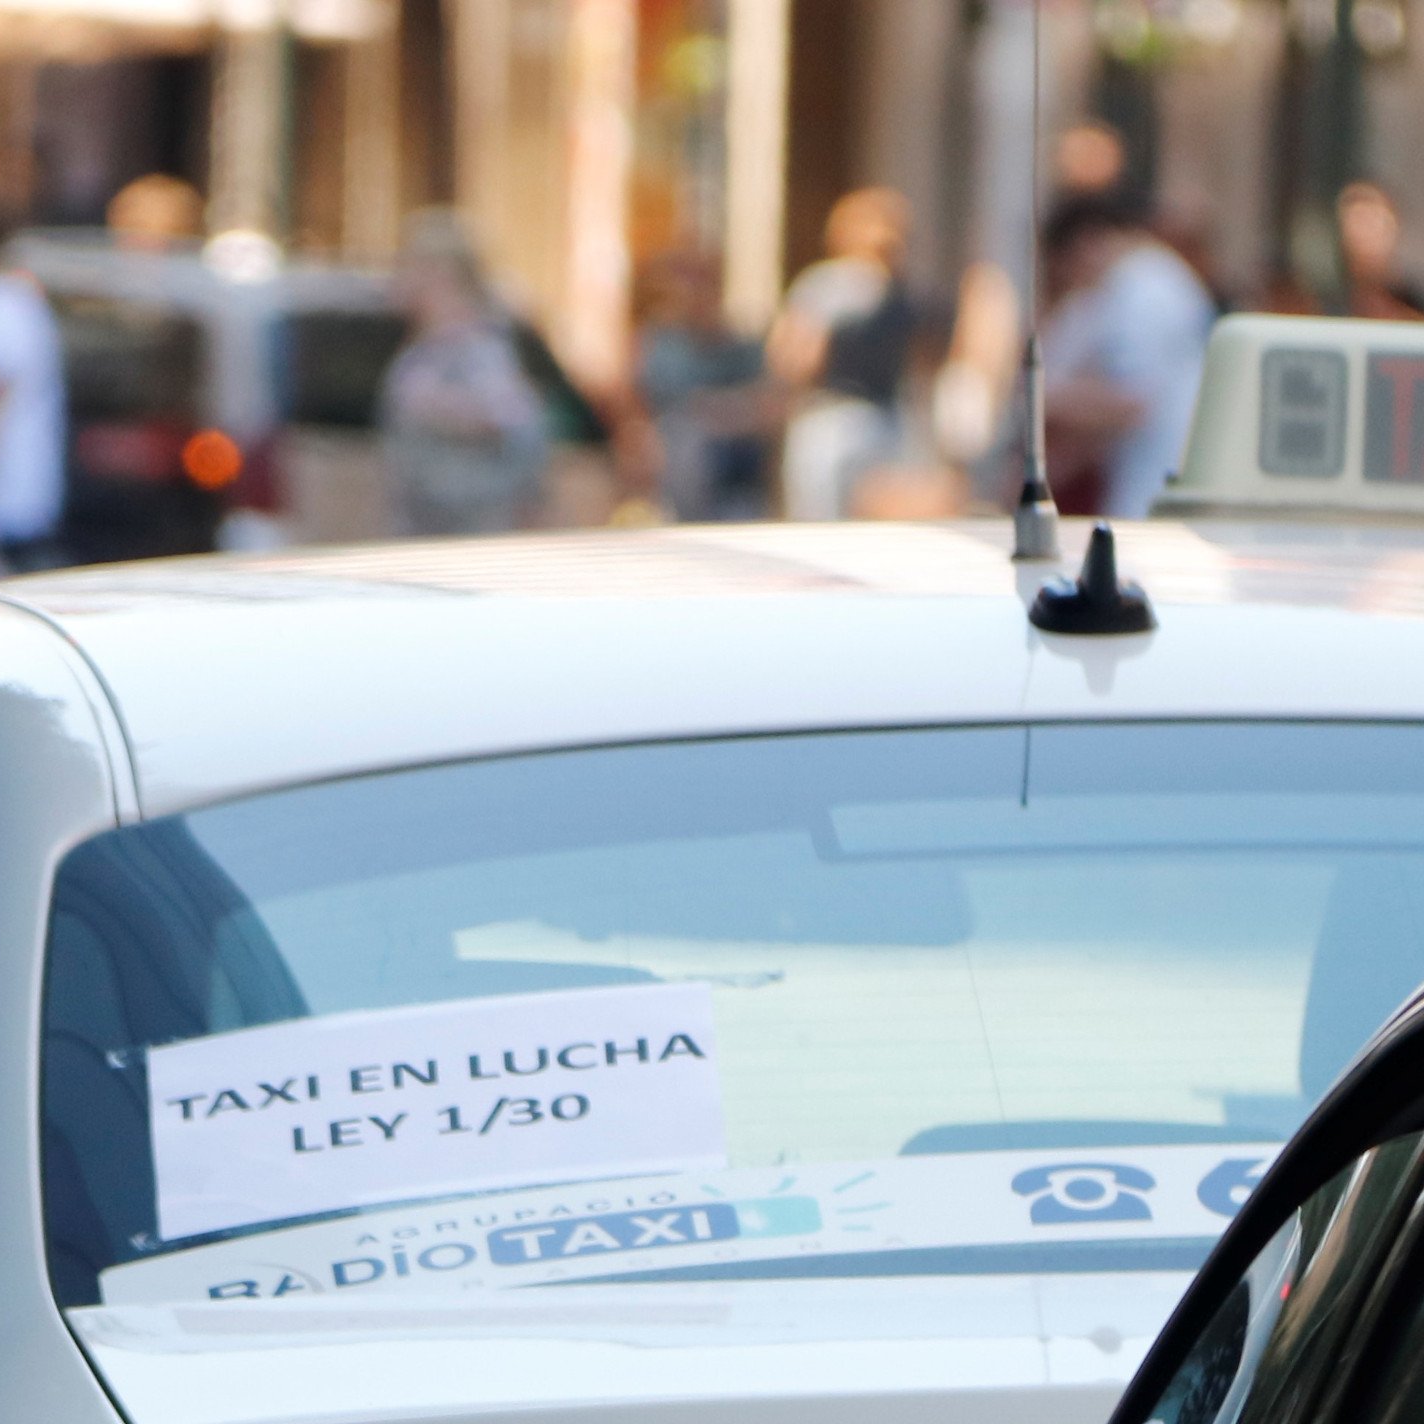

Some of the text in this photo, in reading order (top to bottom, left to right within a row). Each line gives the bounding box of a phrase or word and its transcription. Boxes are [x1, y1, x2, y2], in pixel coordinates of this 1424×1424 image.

[170, 1032, 707, 1121] TAXI EN LUCHA
[292, 1092, 591, 1153] LEY 1/30
[503, 1209, 713, 1260] TAXI
